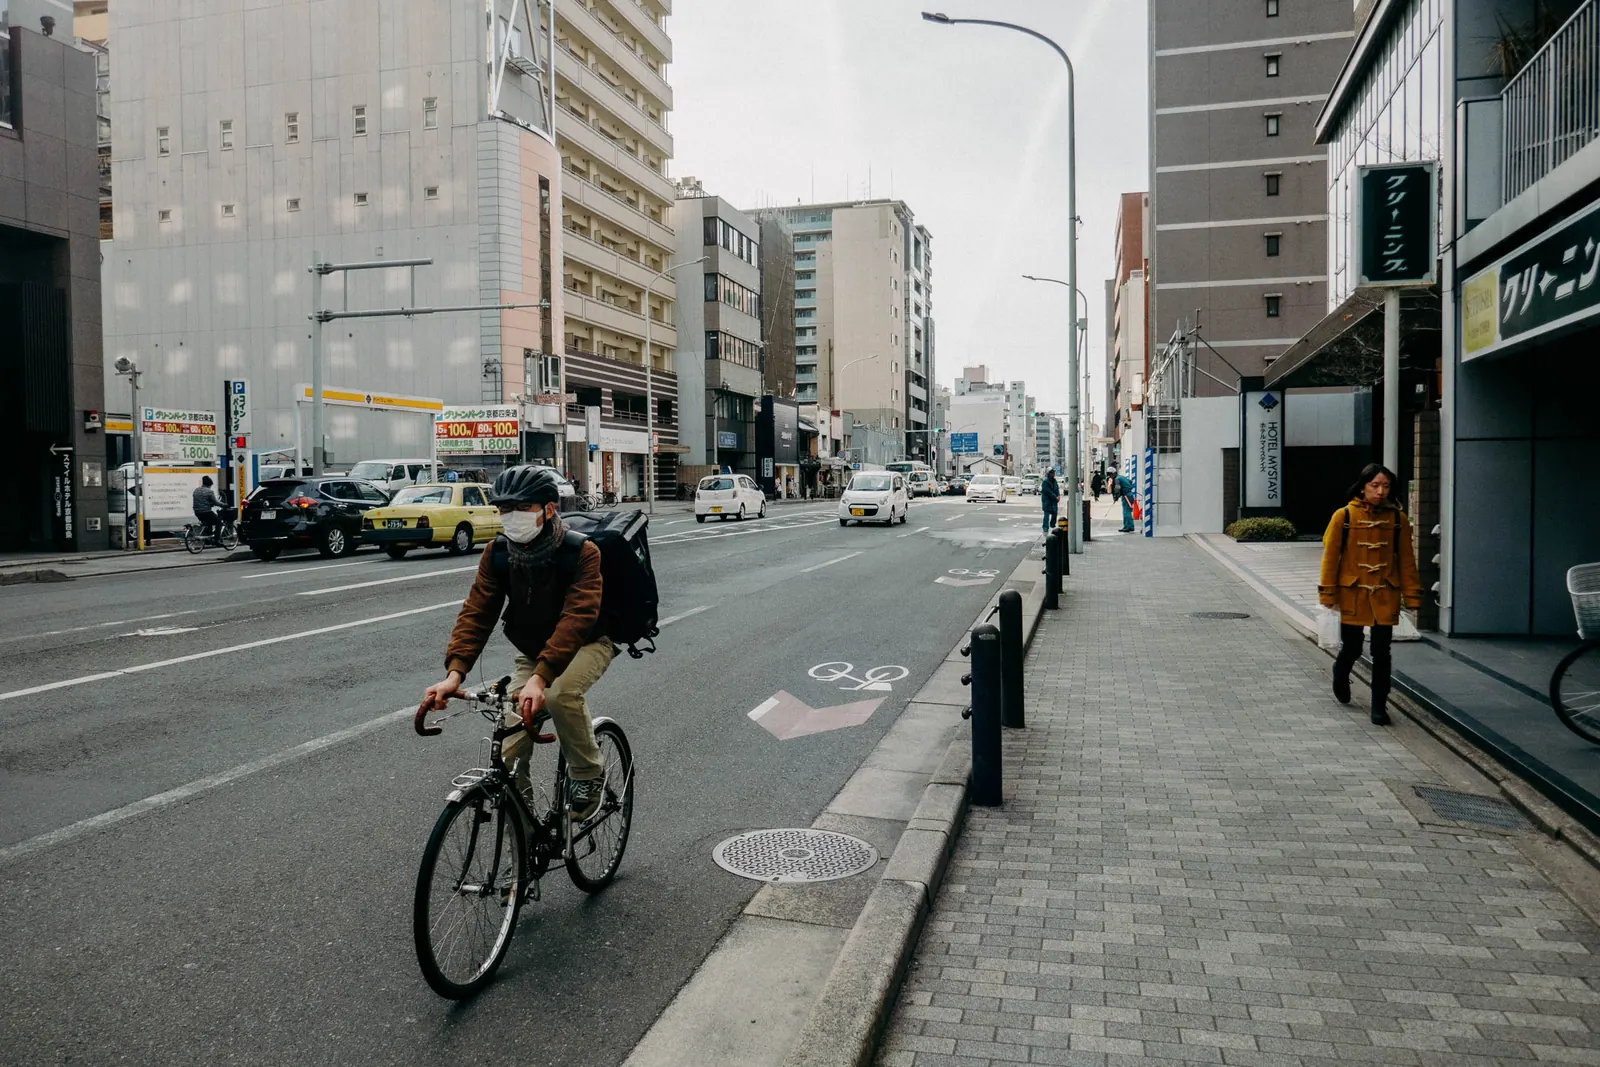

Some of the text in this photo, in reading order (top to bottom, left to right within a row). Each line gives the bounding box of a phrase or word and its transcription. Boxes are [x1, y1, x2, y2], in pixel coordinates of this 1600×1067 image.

[235, 383, 242, 394] P
[444, 409, 486, 419] グリーンパーク
[1268, 422, 1278, 500] HOTEL MYSTAYS
